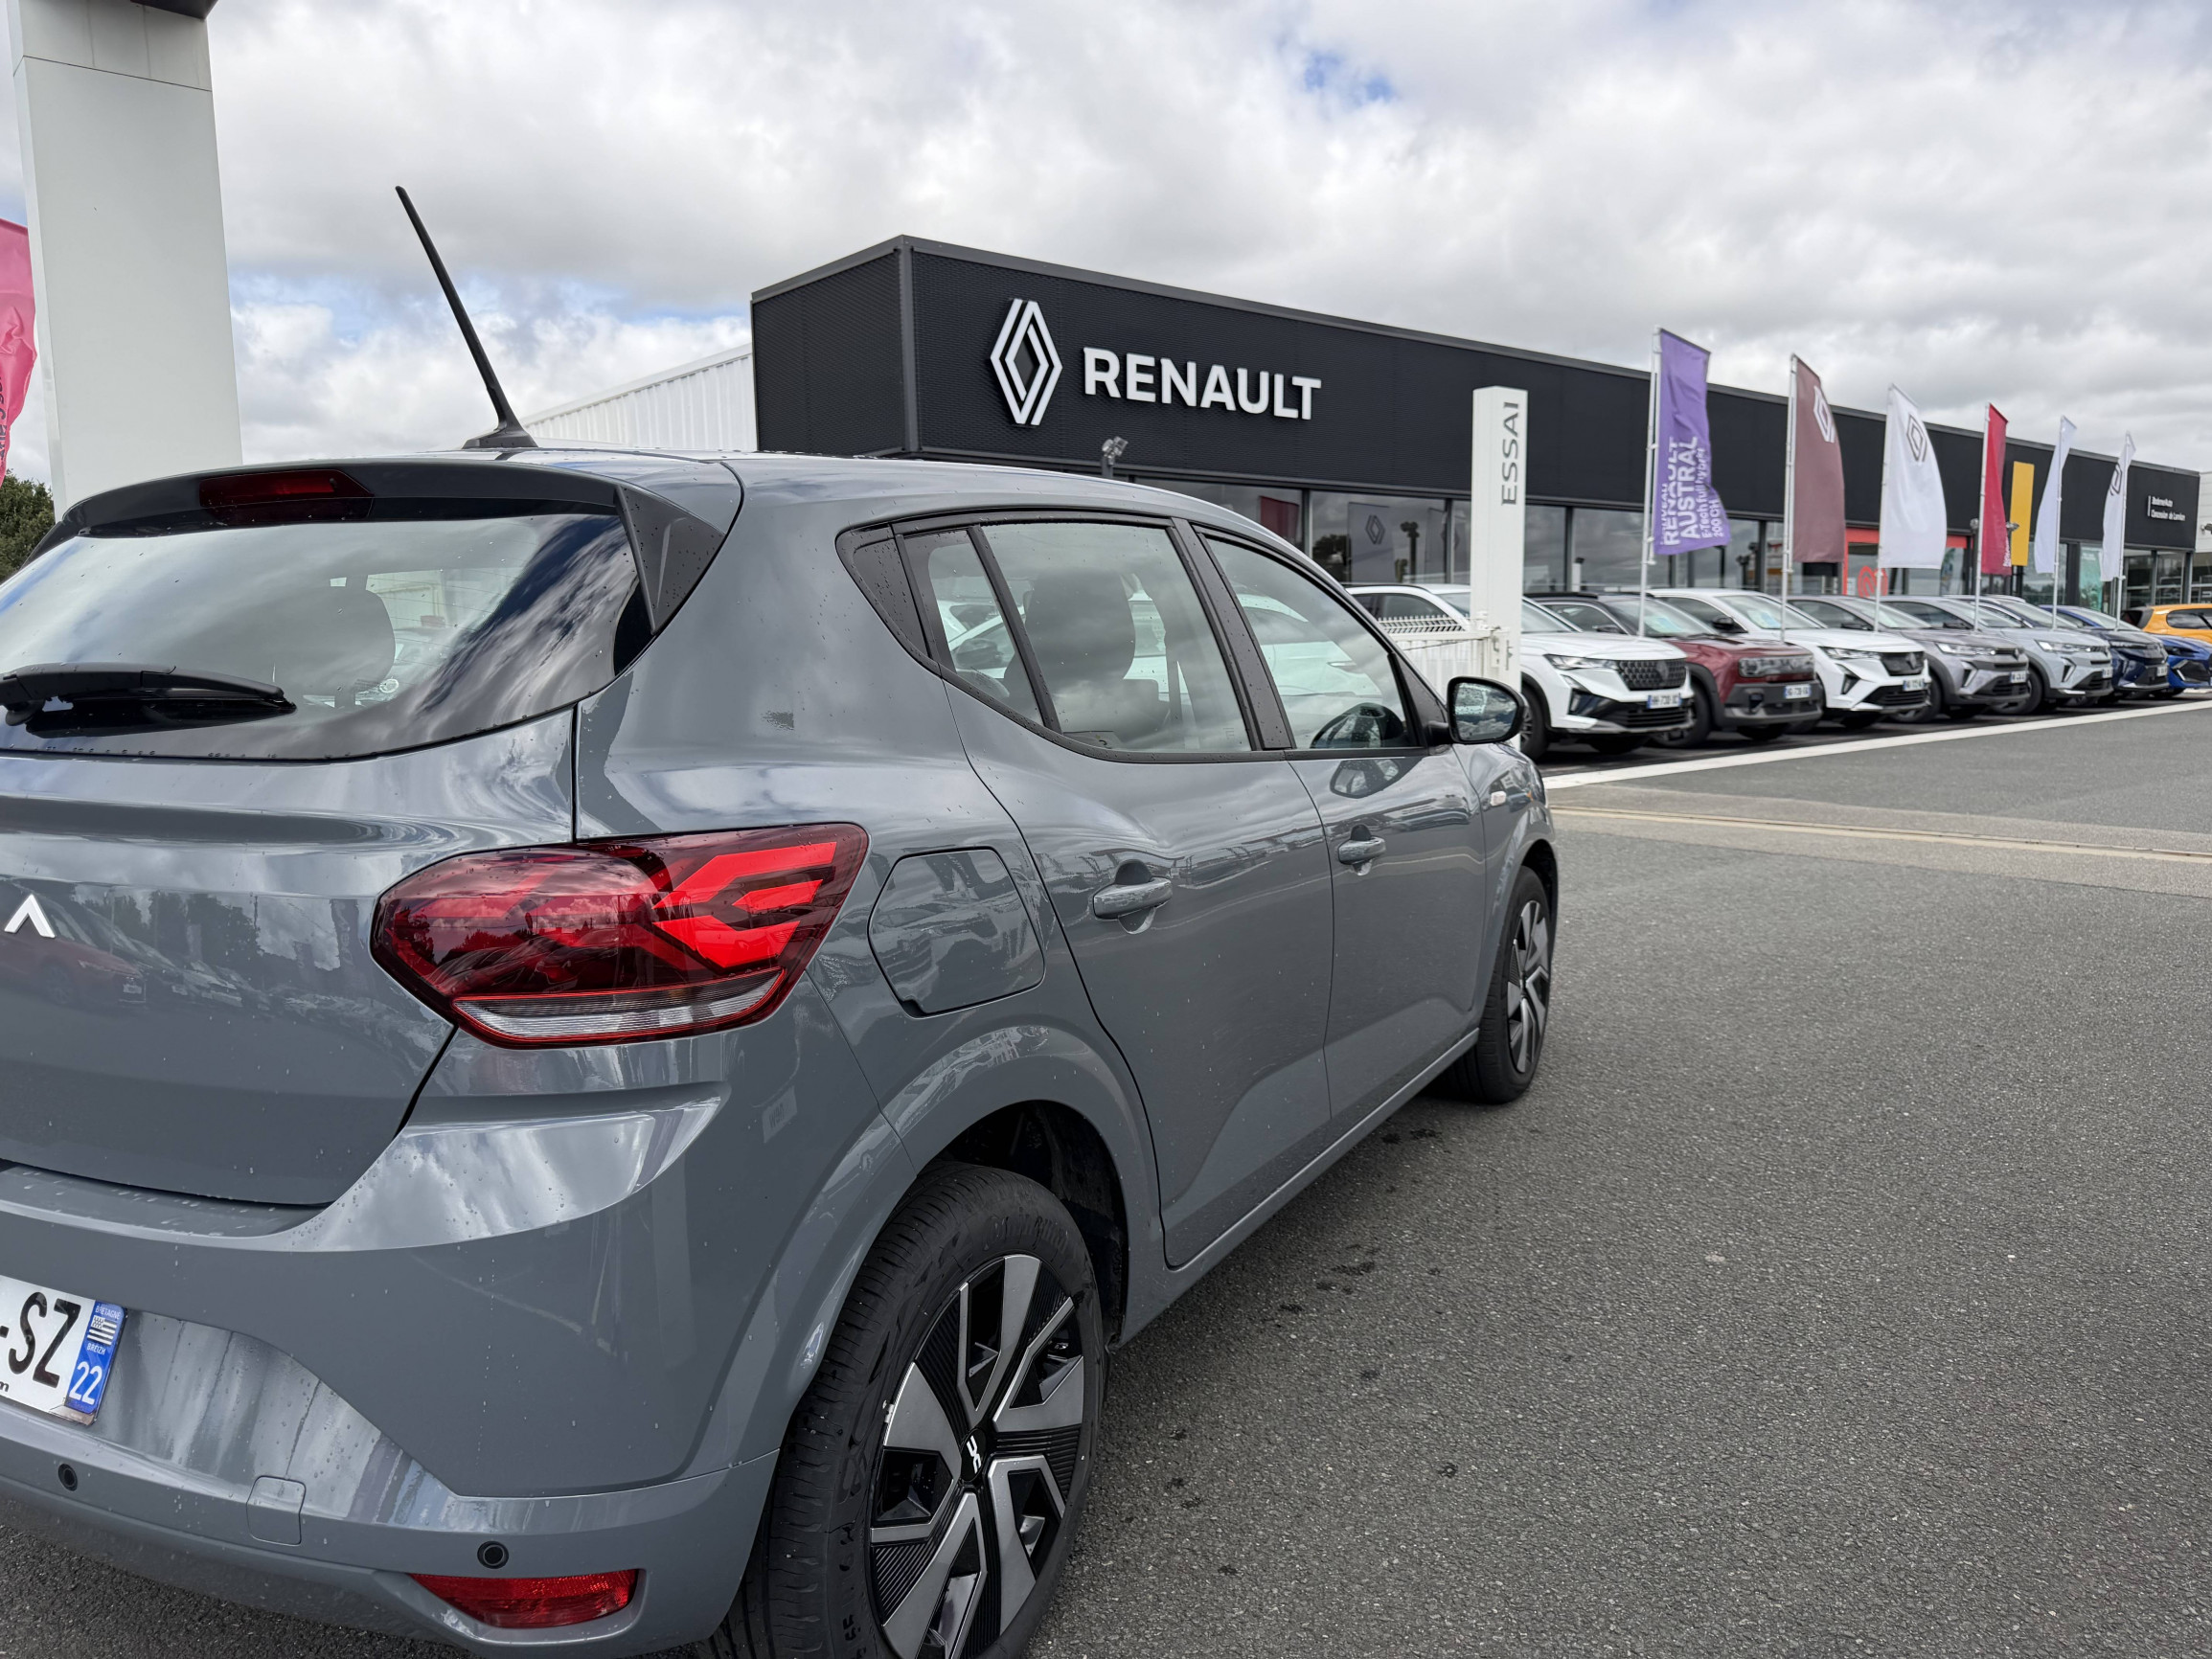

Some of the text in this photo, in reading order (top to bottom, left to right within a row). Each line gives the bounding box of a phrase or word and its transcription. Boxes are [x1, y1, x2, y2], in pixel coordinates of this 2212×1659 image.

[1083, 347, 1322, 420] RENAULT
[1501, 401, 1518, 506] ESSAI
[1677, 436, 1701, 538] AUSTRAL
[95, 1305, 122, 1320] BRETAGNE
[86, 1342, 106, 1355] BREIZH
[69, 1361, 103, 1405] 22
